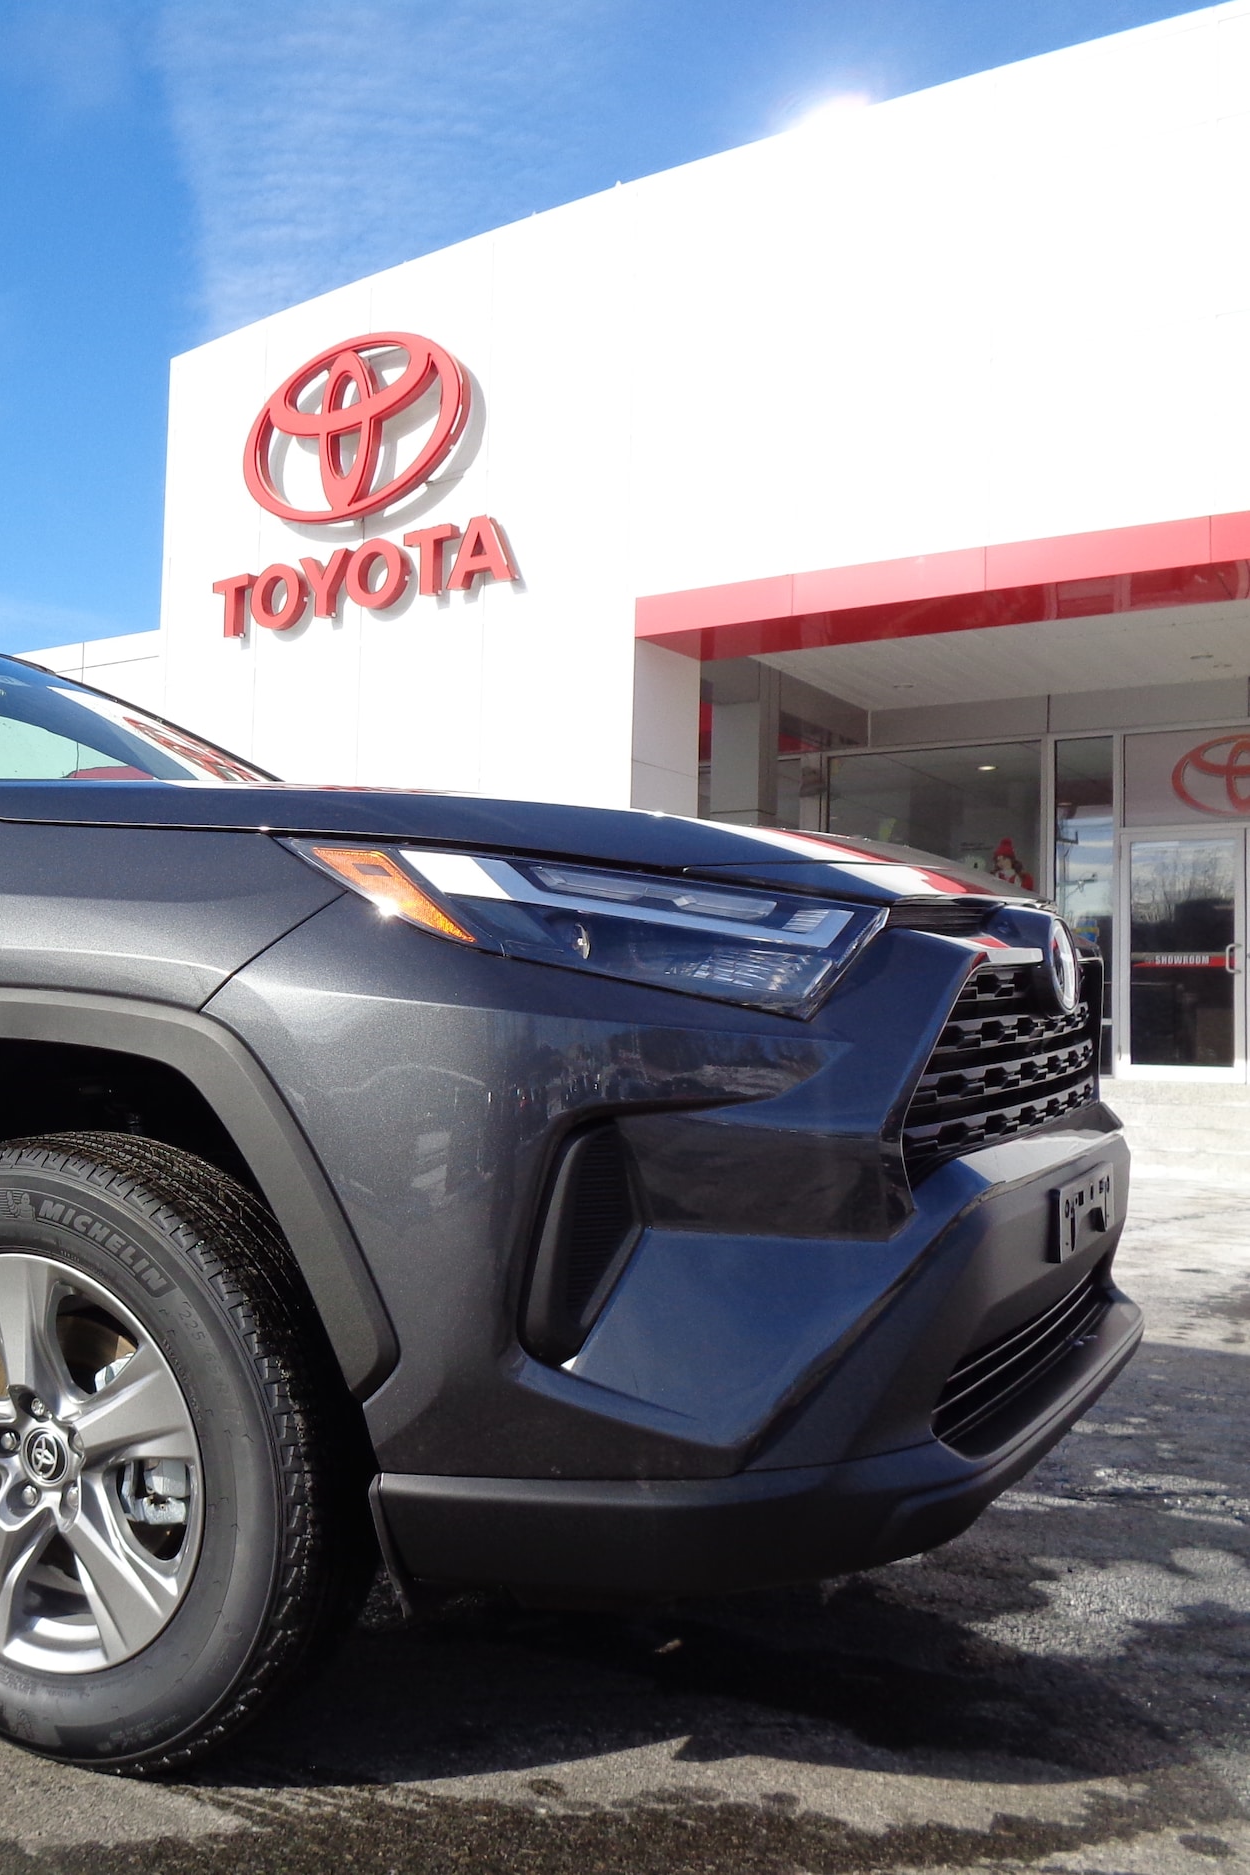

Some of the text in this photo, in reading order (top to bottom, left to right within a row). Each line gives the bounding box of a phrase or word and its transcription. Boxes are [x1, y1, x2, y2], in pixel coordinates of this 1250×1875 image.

[212, 514, 519, 639] TOYOTA
[1155, 955, 1210, 965] SHOWROOM
[38, 1199, 170, 1291] MICHELIN
